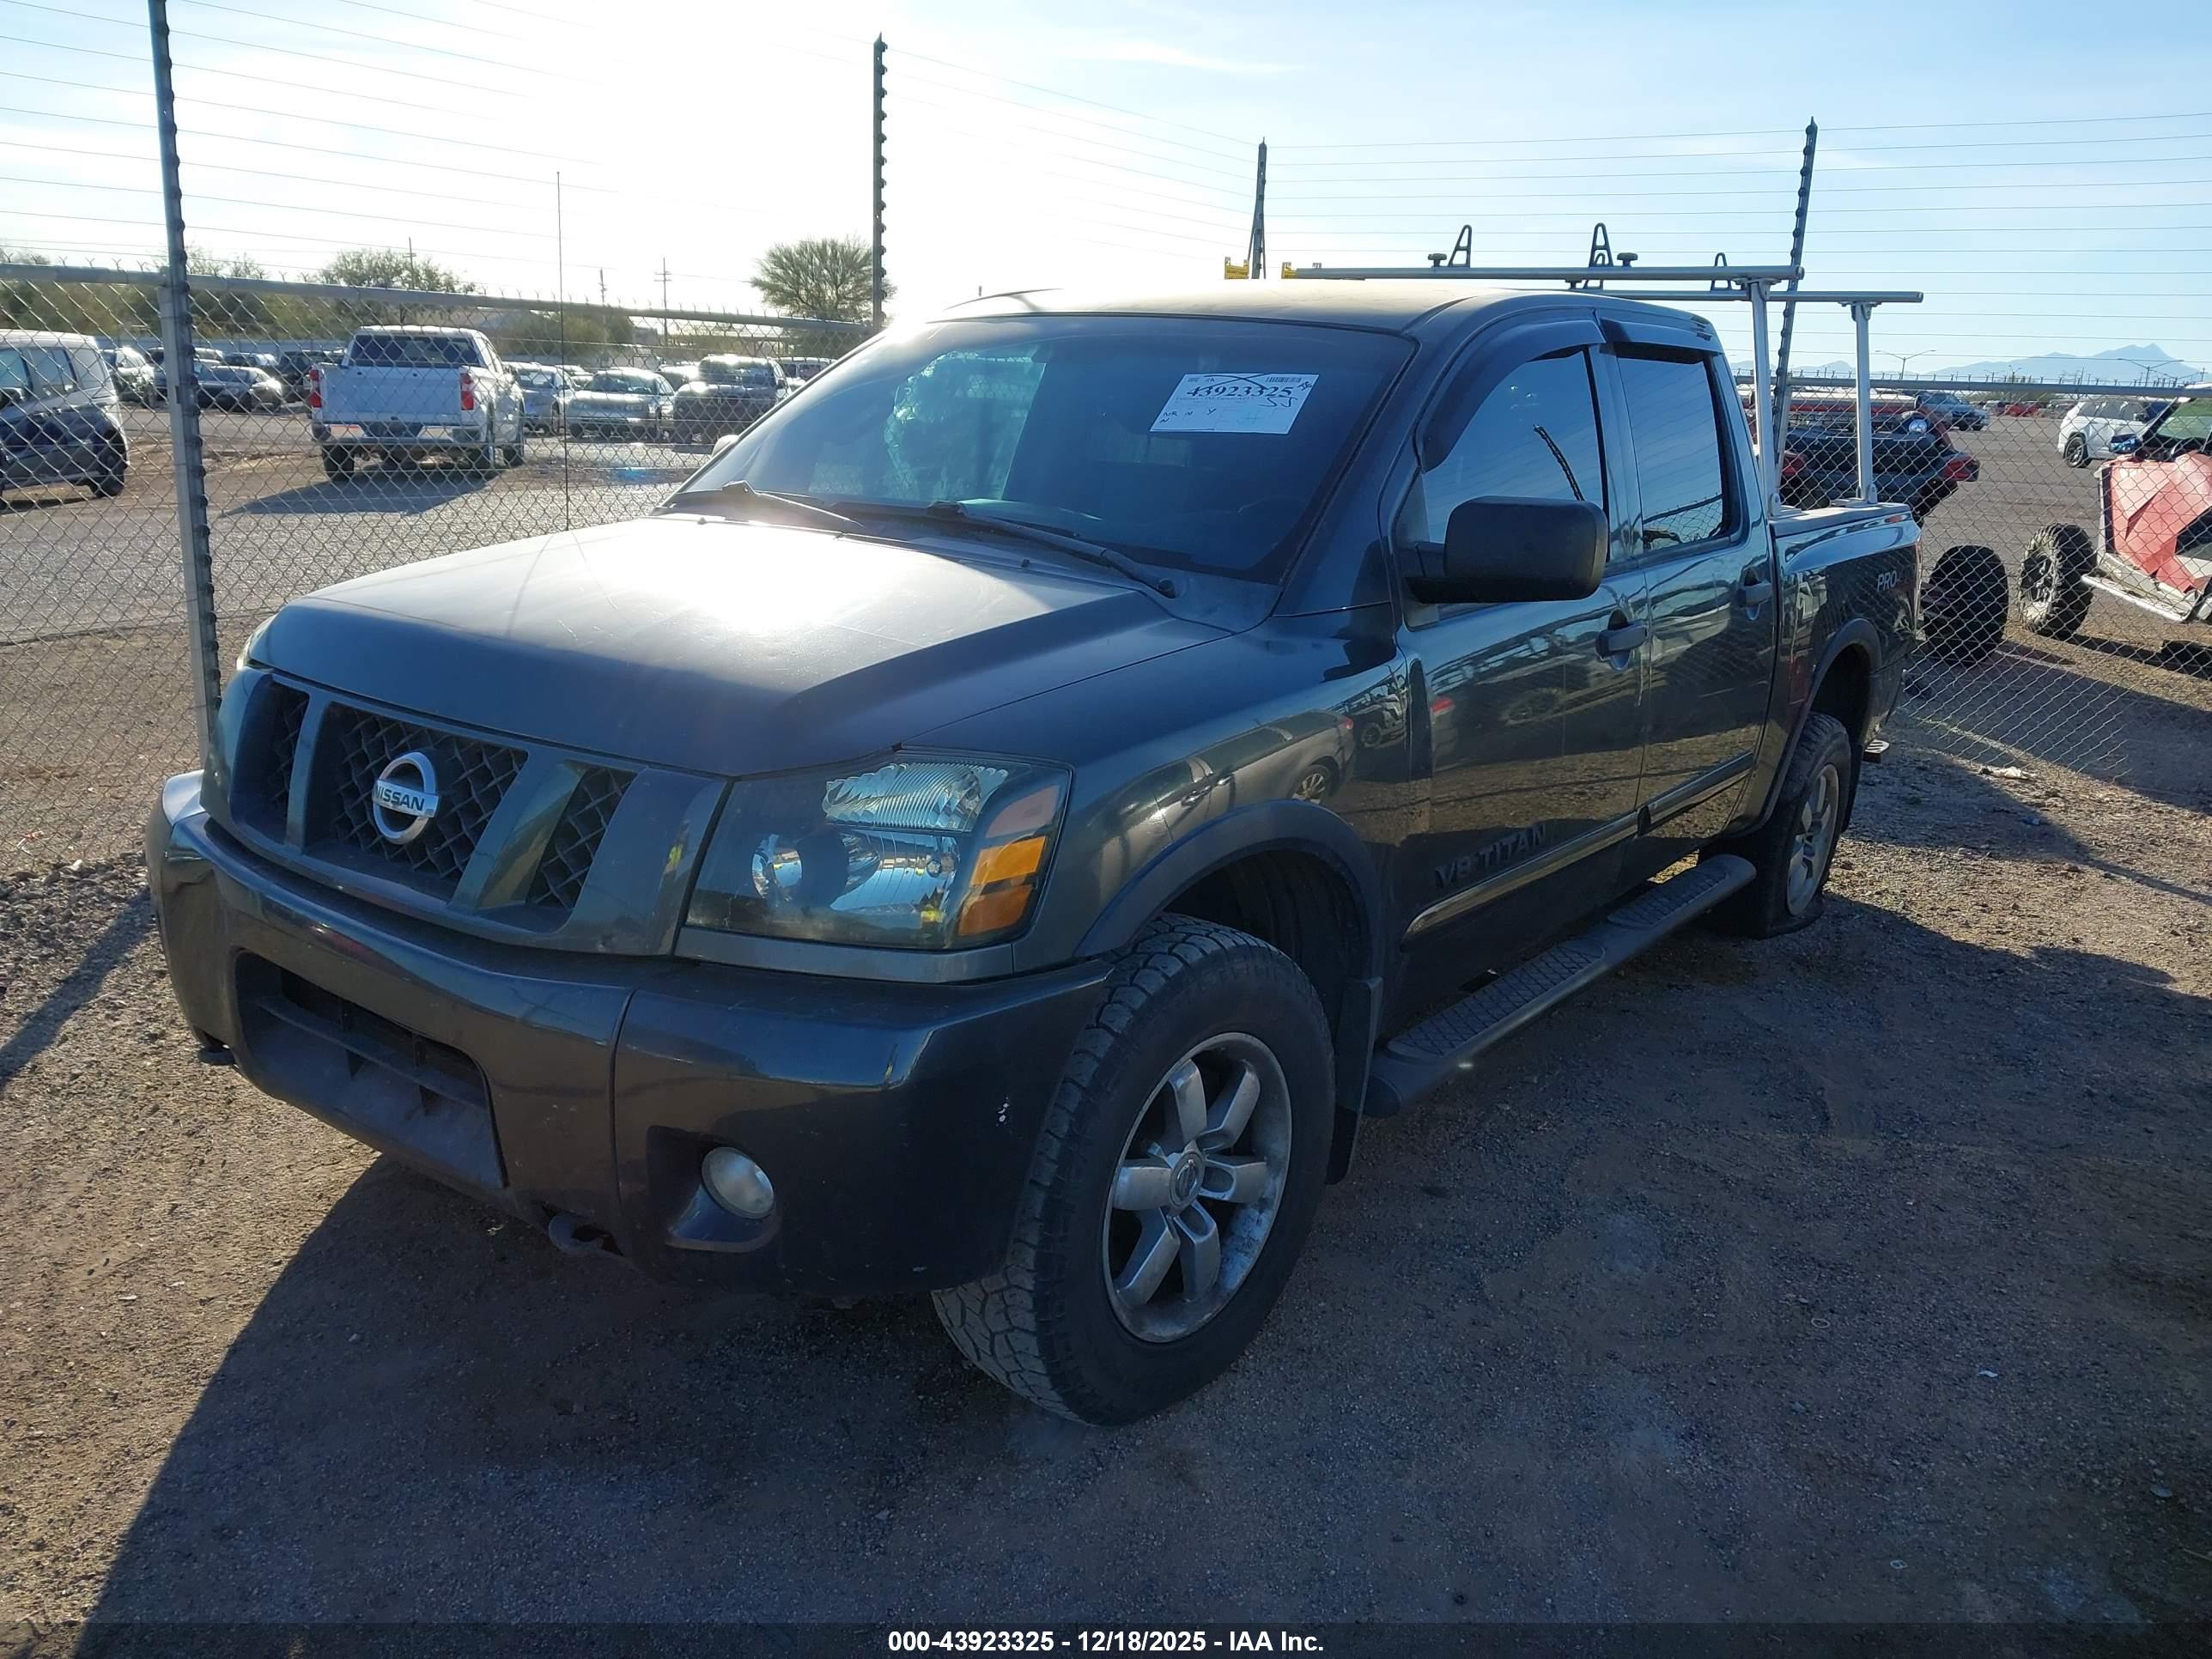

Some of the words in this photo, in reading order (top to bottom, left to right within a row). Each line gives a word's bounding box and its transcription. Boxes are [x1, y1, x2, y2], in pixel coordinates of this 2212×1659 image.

[1186, 386, 1292, 397] 43923325
[376, 785, 425, 811] NISSAN
[1478, 823, 1546, 870] TITAN
